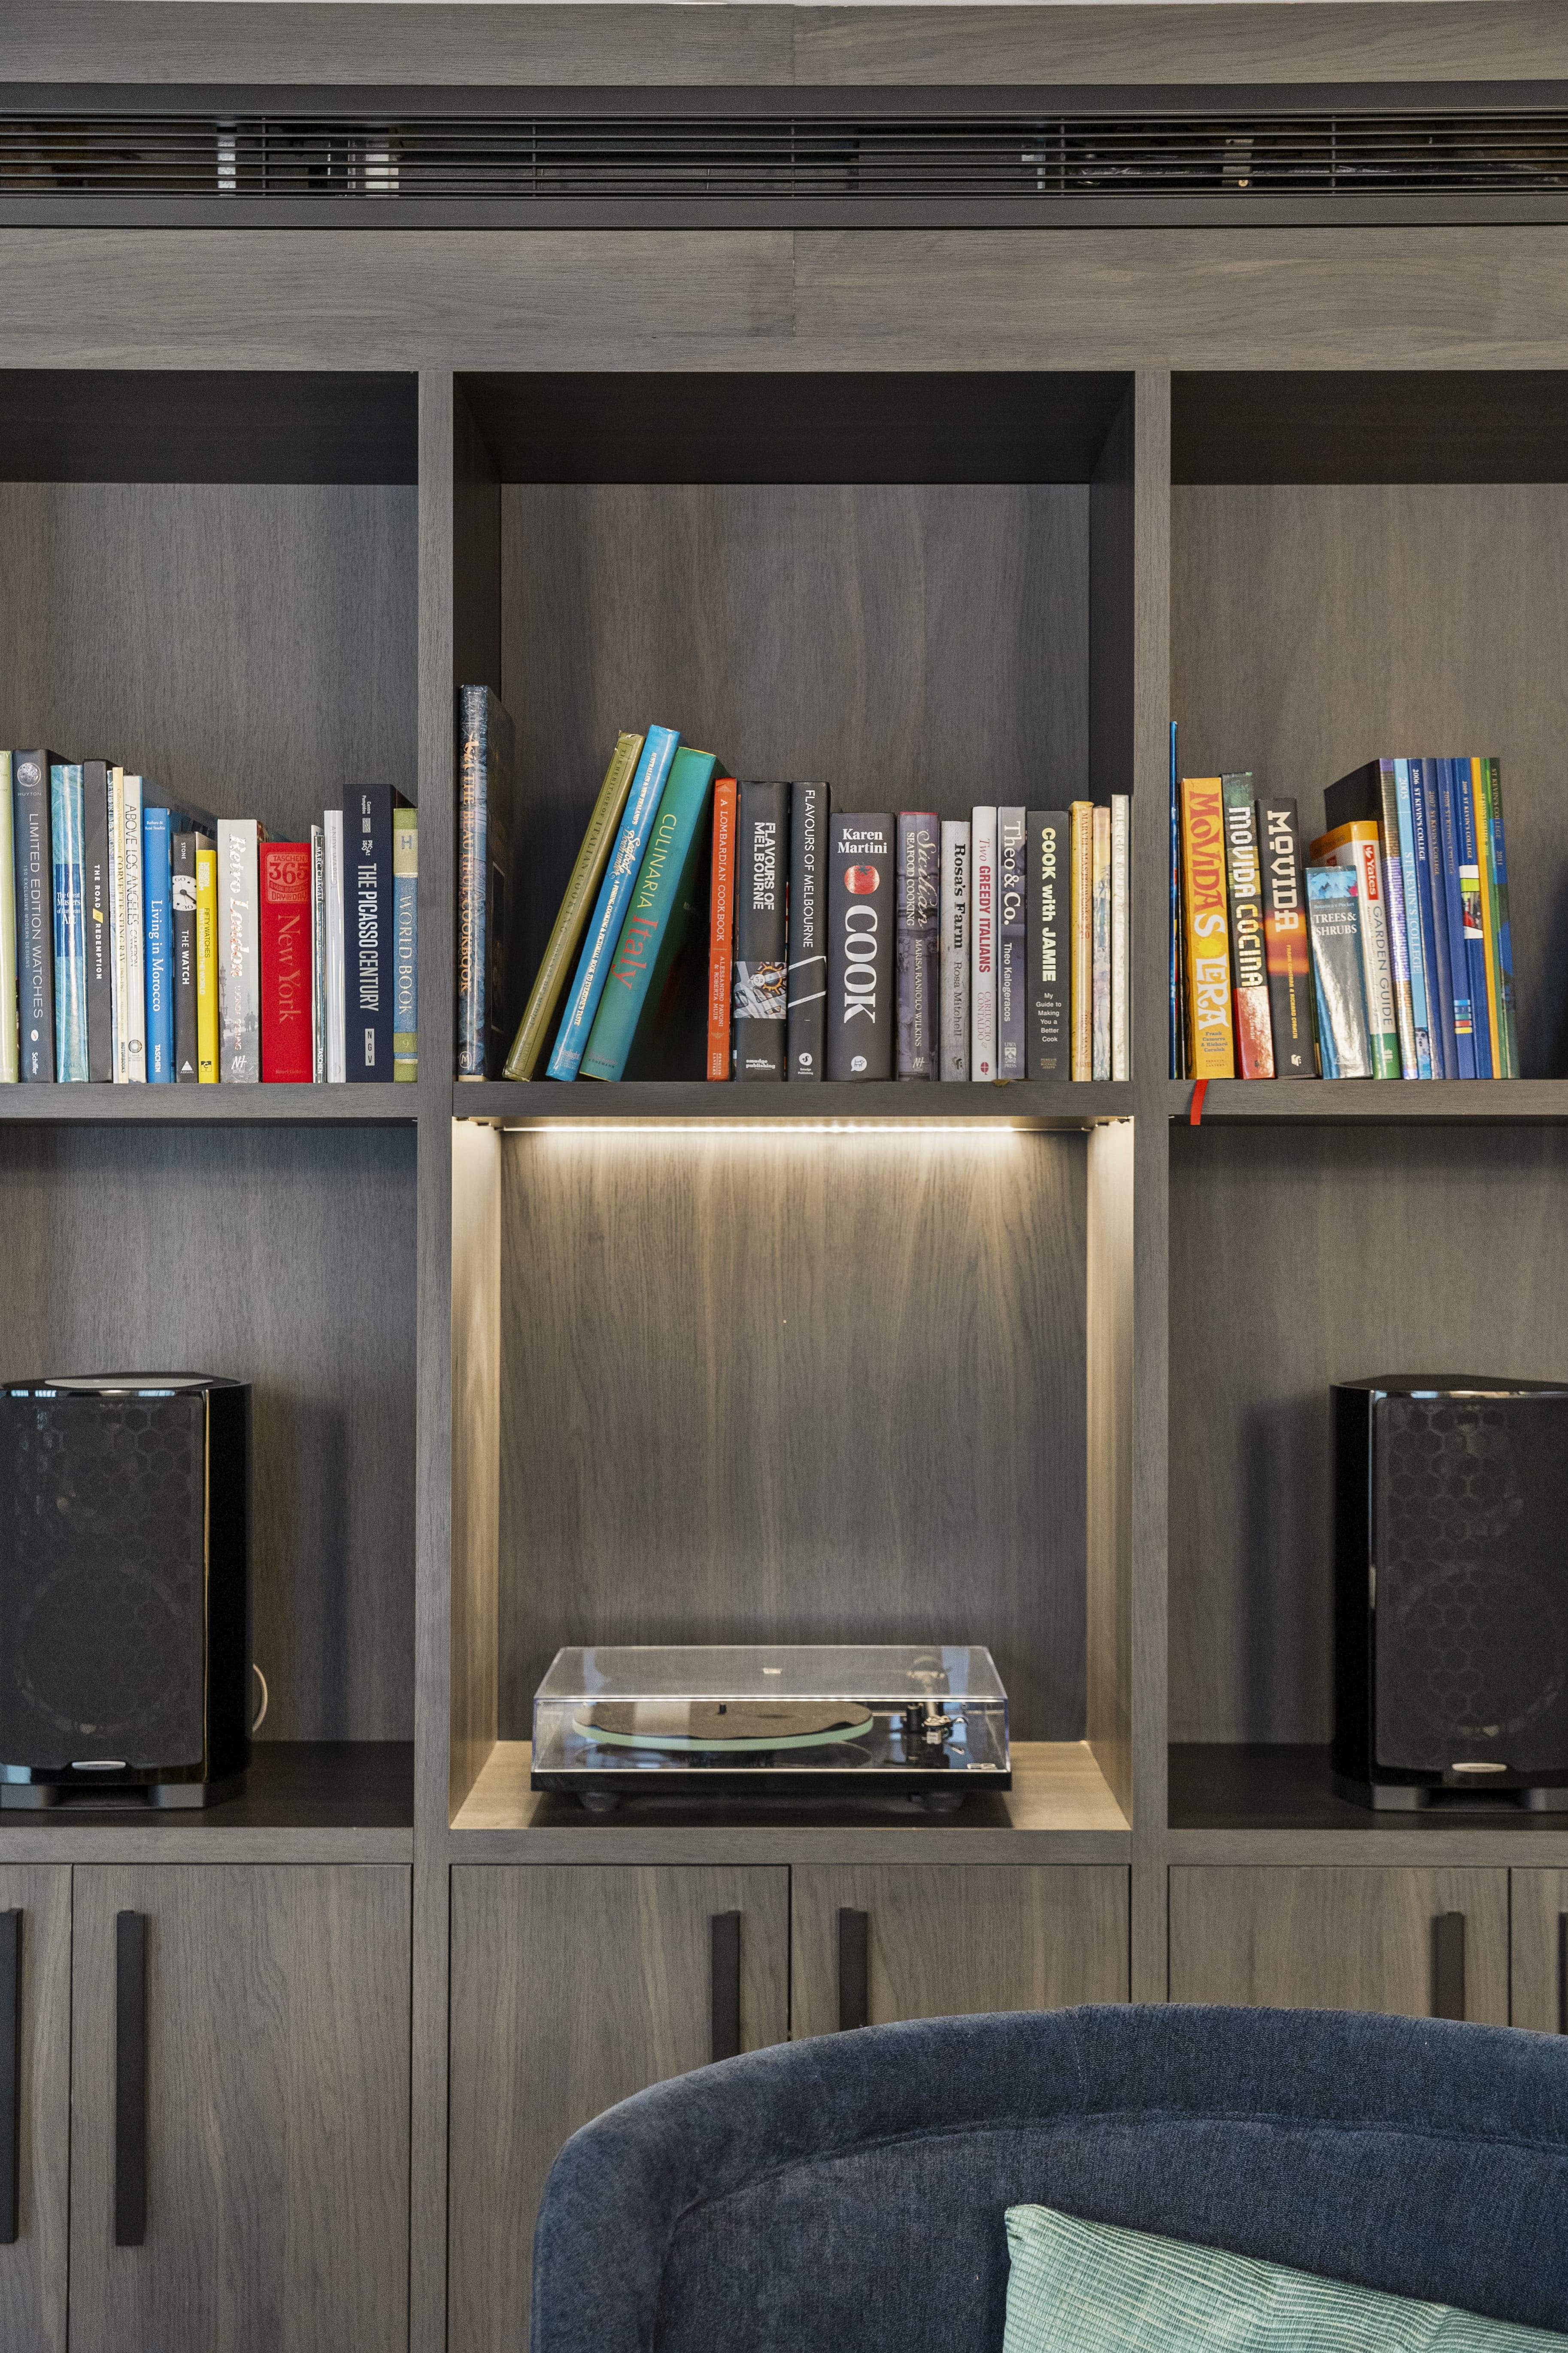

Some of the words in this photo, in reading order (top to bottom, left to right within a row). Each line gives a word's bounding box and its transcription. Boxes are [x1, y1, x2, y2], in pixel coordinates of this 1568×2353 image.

[463, 774, 474, 804] THE
[1399, 777, 1409, 800] 2005
[1414, 788, 1421, 796] ST
[29, 813, 40, 873] LIMITED
[125, 804, 137, 845] ABOVE
[401, 835, 412, 849] H
[804, 789, 816, 852] FLAVOURS
[842, 829, 883, 840] Karen
[1417, 828, 1425, 861] COLLEGE
[126, 849, 138, 870] LOS
[230, 834, 246, 893] Retro
[462, 810, 474, 897] BEAUTIFUL
[581, 821, 602, 870] ITALIAN
[621, 835, 641, 875] Seafood
[637, 814, 677, 908] CULINARIA
[718, 811, 728, 881] LOMBARDIAN
[753, 822, 765, 910] MELBOURNE
[764, 822, 776, 889] FLAVOURS
[804, 854, 814, 871] OF
[837, 842, 887, 854] Martini
[907, 832, 915, 877] SEAFOOD
[979, 838, 990, 861] Two
[1004, 820, 1022, 870] Theo
[1042, 828, 1056, 880] COOK
[1189, 791, 1225, 914] MOVIDA
[1404, 852, 1414, 865] ST
[269, 862, 309, 884] 365
[358, 863, 377, 888] THE
[916, 829, 937, 929] Sicilian
[954, 843, 966, 897] Rosa's
[979, 865, 991, 913] GREEDY
[1004, 874, 1019, 888] &
[1267, 810, 1299, 932] MOVIDA
[1366, 859, 1377, 895] Yates
[1406, 871, 1419, 915] KEVIN'S
[31, 879, 41, 940] EDITION
[127, 873, 139, 925] ANGELES
[149, 900, 163, 939] Living
[272, 891, 285, 901] DAY
[293, 891, 306, 901] DAY
[358, 891, 378, 948] PICASSO
[560, 873, 585, 933] COOKING
[602, 905, 613, 928] COOKING
[716, 885, 725, 942] COOKBOOK
[764, 893, 774, 910] OF
[803, 874, 814, 948] MELBOURNE
[907, 880, 915, 927] COOKING
[1004, 891, 1021, 925] Co.
[1042, 884, 1056, 922] with
[1313, 913, 1347, 924] TREES
[1347, 912, 1357, 921] &
[152, 942, 163, 955] in
[230, 897, 250, 977] London
[278, 914, 300, 966] New
[398, 895, 412, 959] WORLD
[461, 898, 473, 992] COOKBOOK
[593, 933, 605, 959] PICTORIAL
[954, 902, 965, 949] Farm
[979, 915, 991, 973] ITALIANS
[1315, 924, 1357, 936] SHRUBS
[1373, 906, 1387, 970] GARDEN
[1410, 919, 1421, 973] COLLEGE
[182, 950, 190, 985] WATCH
[589, 959, 597, 973] BOOK
[612, 913, 659, 990] Italy
[843, 904, 878, 1024] COOK
[953, 961, 962, 988] Rosa
[1004, 942, 1013, 965] Theo
[1042, 927, 1056, 982] JAMIE
[32, 945, 43, 1018] WATCHES
[152, 958, 164, 1012] Morocco
[279, 970, 301, 1024] York
[359, 950, 379, 1011] CENTURY
[398, 965, 412, 1015] BOOK
[1003, 967, 1013, 1022] Kalogeracos
[1379, 977, 1392, 1026] GUIDE
[574, 1010, 583, 1026] TASTE
[953, 992, 962, 1036] Mitchell
